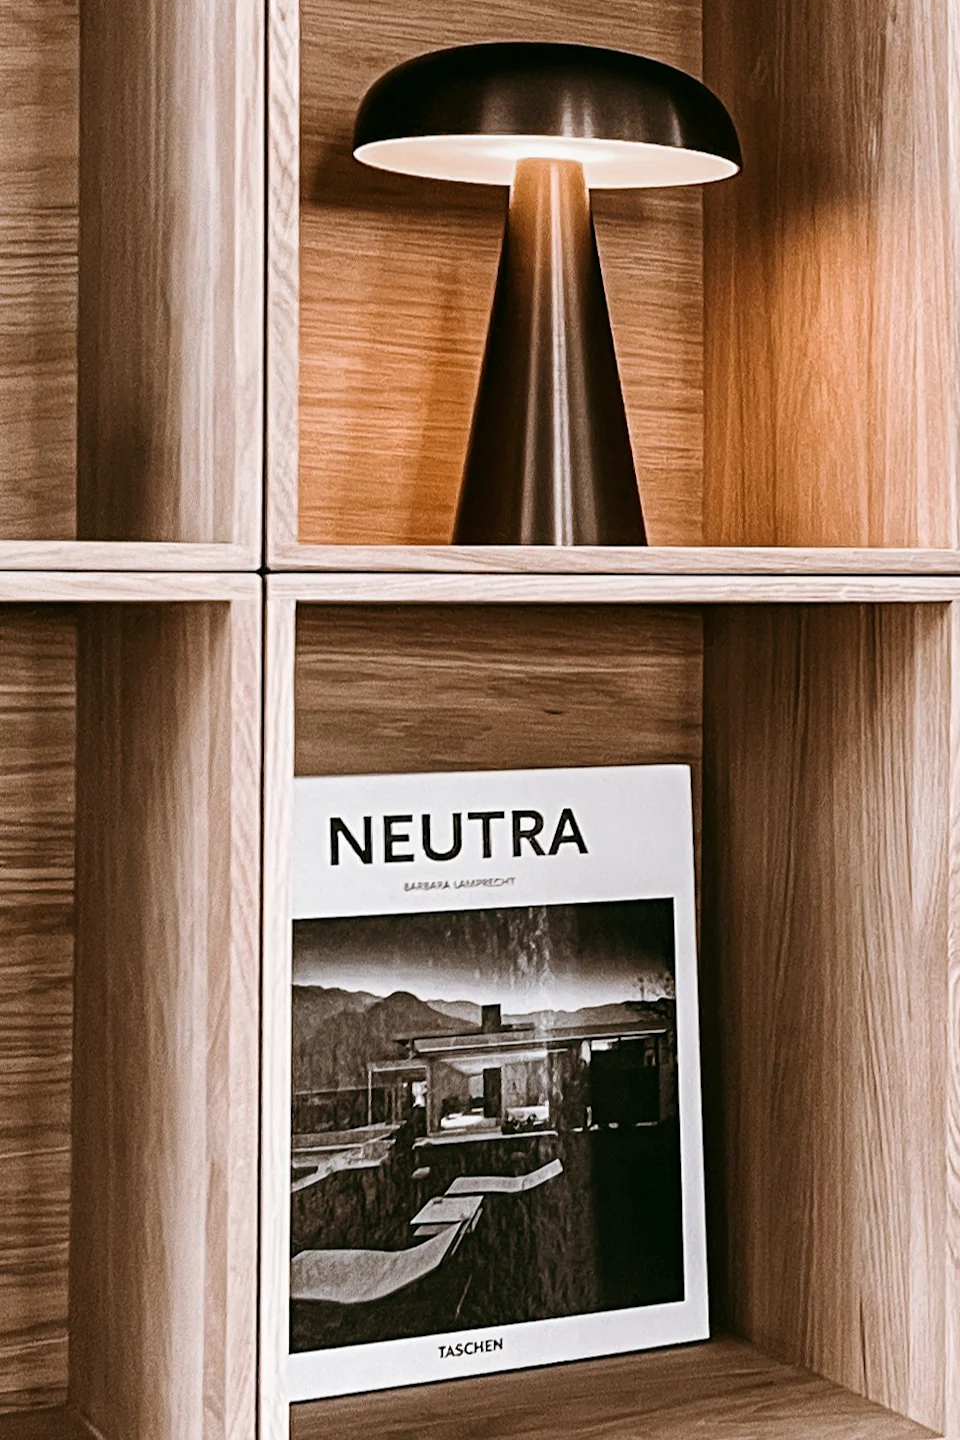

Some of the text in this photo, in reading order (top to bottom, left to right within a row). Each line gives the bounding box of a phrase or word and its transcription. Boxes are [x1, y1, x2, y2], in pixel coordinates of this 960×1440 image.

[330, 808, 588, 866] NEUTRA
[403, 880, 450, 892] BARBARA
[438, 1338, 503, 1359] TASCHEN
